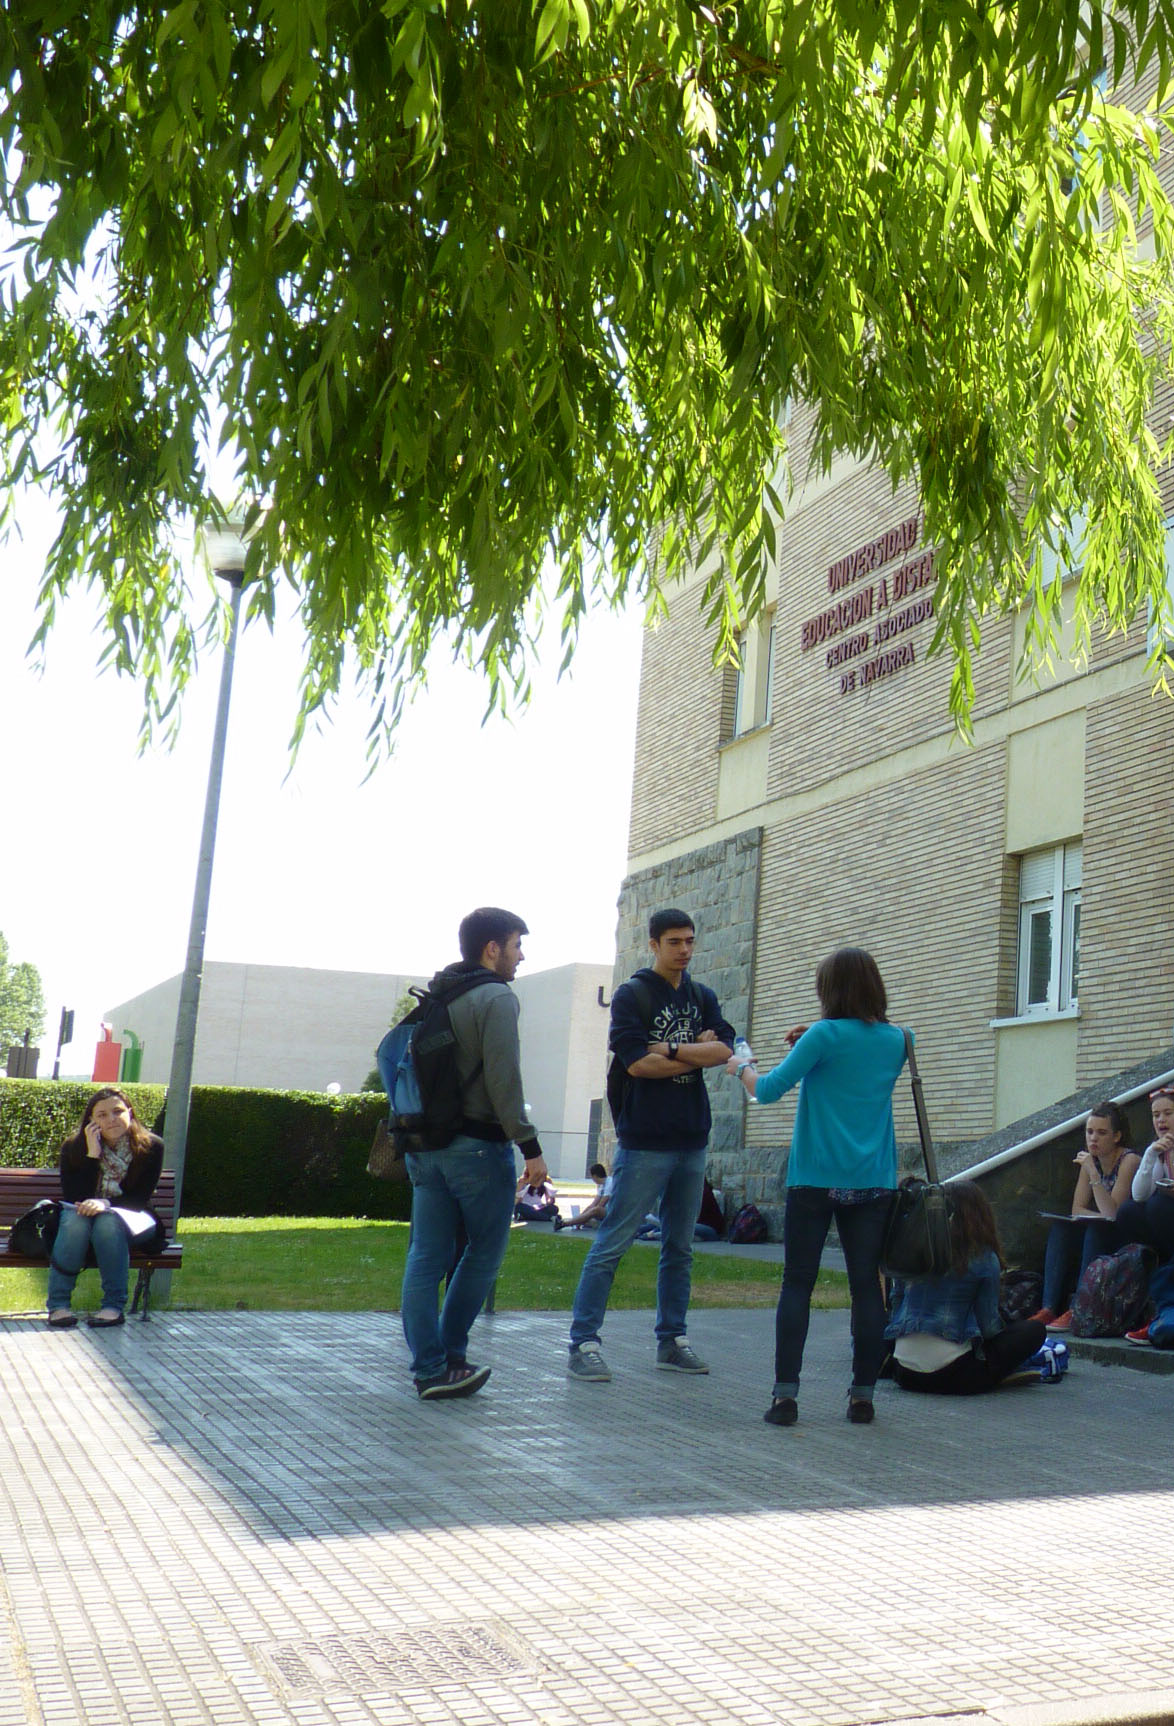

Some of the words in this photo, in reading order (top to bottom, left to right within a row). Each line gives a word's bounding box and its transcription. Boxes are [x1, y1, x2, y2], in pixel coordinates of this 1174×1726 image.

[827, 517, 917, 594] UNIVERSIDAD
[801, 586, 874, 652] EDUCACION
[876, 579, 889, 611] A
[825, 631, 869, 670] CENTRO
[873, 597, 934, 646] ASOCIADO
[839, 670, 856, 695] DE
[859, 642, 916, 687] NAVARRA
